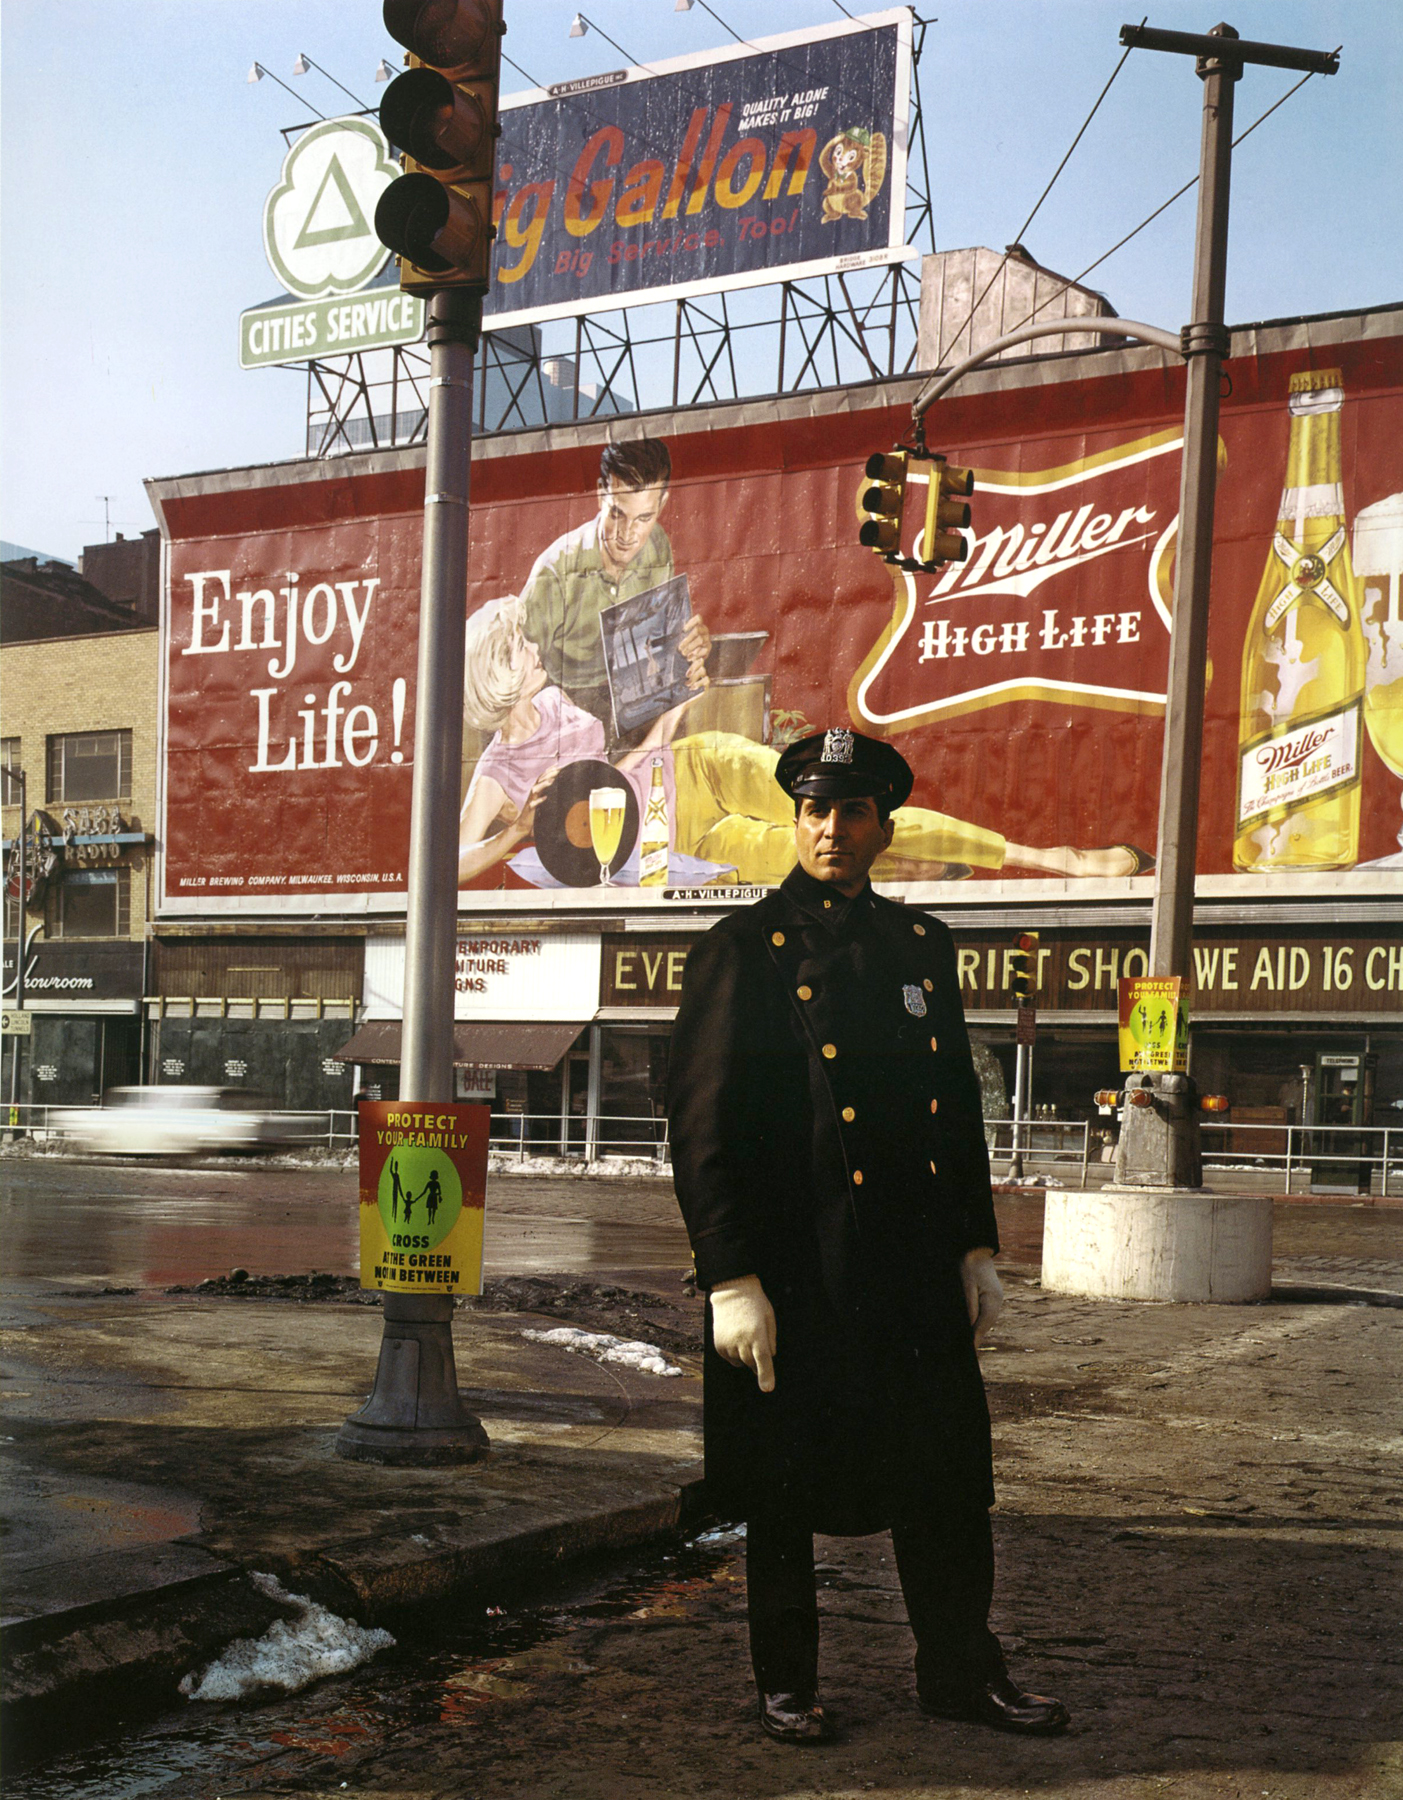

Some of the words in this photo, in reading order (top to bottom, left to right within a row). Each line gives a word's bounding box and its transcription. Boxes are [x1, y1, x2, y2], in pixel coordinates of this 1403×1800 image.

[743, 94, 789, 118] QUALITY
[791, 86, 829, 107] ALONE
[738, 112, 778, 131] MAKES
[780, 109, 792, 123] IT
[793, 103, 819, 120] BIG!
[488, 163, 556, 284] ig
[565, 101, 817, 237] Gallon
[554, 249, 594, 278] Big
[738, 209, 799, 241] Too!
[835, 260, 866, 270] HARDWARE
[840, 255, 861, 263] BRIDGE
[248, 311, 318, 355] CITIES
[327, 295, 414, 343] SERVICE
[914, 503, 1158, 605] Miller
[1268, 590, 1294, 620] HIGH
[1320, 585, 1344, 613] LIFE
[182, 569, 380, 679] Enjoy
[918, 619, 1030, 664] HIGH
[1039, 609, 1141, 650] LIFE
[249, 677, 407, 772] Life!
[1256, 727, 1339, 775] Miller
[1263, 767, 1299, 794] HIGH
[1303, 754, 1332, 778] LIFE
[65, 843, 120, 860] RADIO
[179, 877, 206, 887] MILLER
[209, 876, 244, 886] BREWING
[382, 872, 403, 882] U.S.A.
[823, 900, 832, 909] B
[456, 939, 540, 954] EMPORARY
[615, 951, 687, 991] EVE
[957, 949, 1051, 990] RIFT
[1067, 948, 1149, 991] SHO
[1193, 947, 1239, 991] WE
[1250, 946, 1311, 991] AID
[1322, 946, 1354, 991] 16
[455, 978, 485, 991] GNS
[1134, 982, 1174, 991] PROTECT
[387, 1112, 458, 1131] PROTECT
[376, 1130, 404, 1147] YOUR
[408, 1131, 469, 1149] FAMILY
[392, 1233, 430, 1249] CROSS
[382, 1251, 390, 1264] AT
[390, 1252, 405, 1266] THE
[408, 1254, 452, 1268] GREEN
[374, 1266, 388, 1279] NOT
[399, 1269, 460, 1284] BETWEEN
